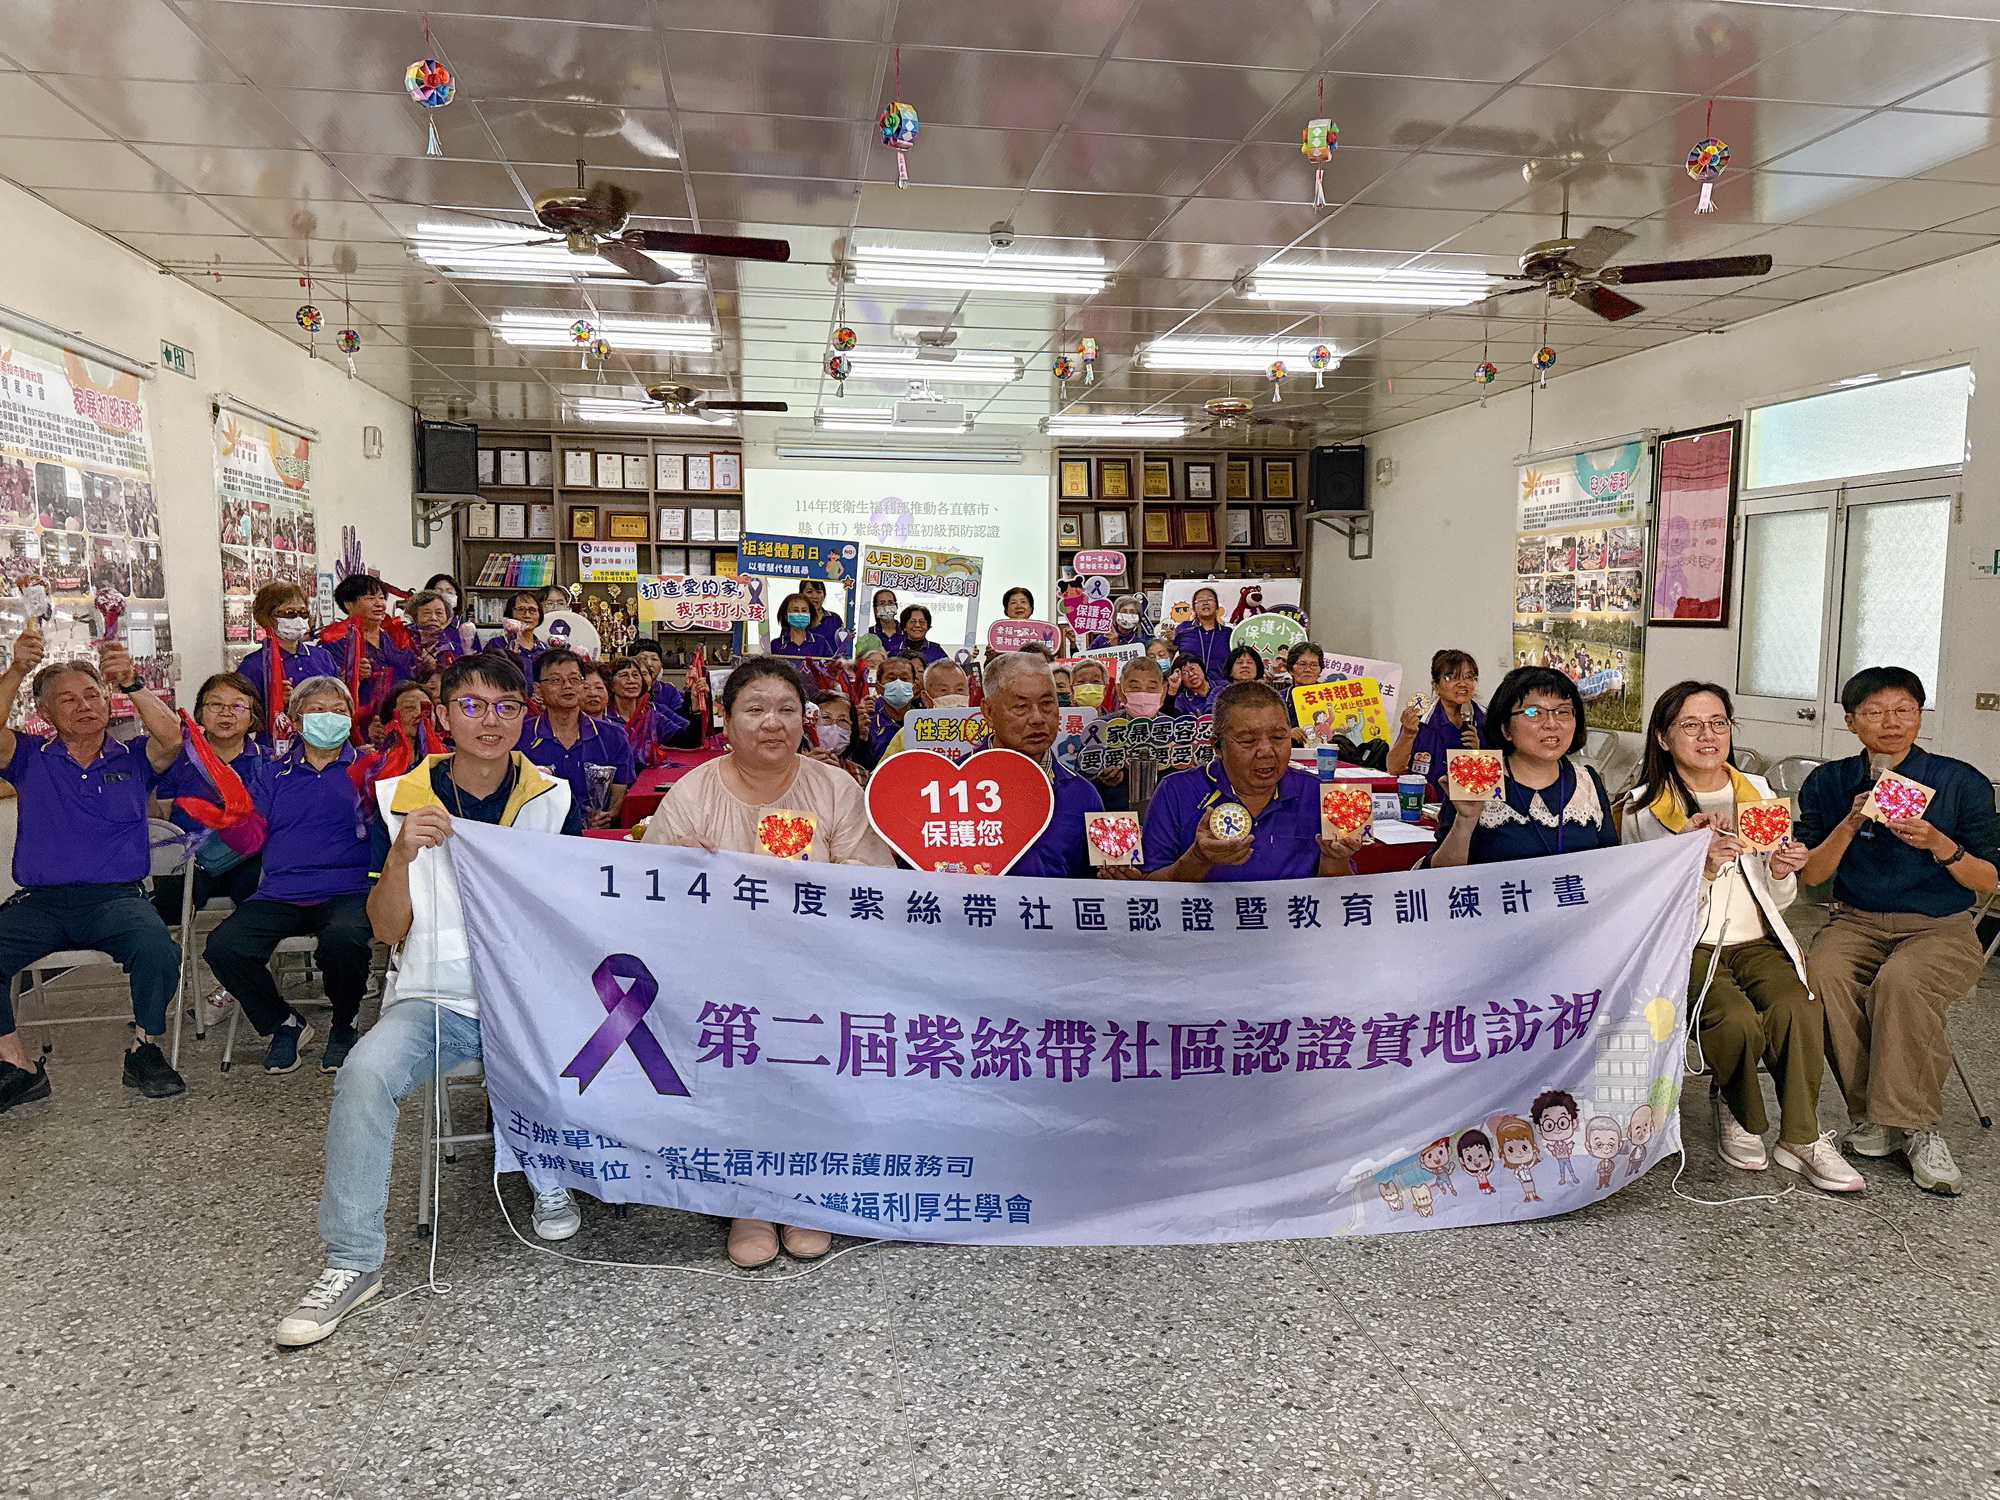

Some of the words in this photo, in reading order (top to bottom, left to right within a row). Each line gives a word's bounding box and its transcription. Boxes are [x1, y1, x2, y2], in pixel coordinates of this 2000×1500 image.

[1590, 471, 1629, 496] 兒少福利
[795, 499, 999, 516] 114年度衛生福利部推動各直轄市、
[798, 521, 1000, 538] 縣（市）紫絲帶社區初級預防認證
[742, 540, 820, 561] 拒絕體罰日
[866, 551, 926, 570] 4月30日
[865, 568, 979, 596] 國際不打小孩日
[676, 602, 765, 621] 我不打小孩
[1076, 605, 1112, 619] 保護令
[1074, 616, 1111, 632] 保護您
[1245, 620, 1304, 645] 保護小孩
[1302, 681, 1364, 706] 支持發聲
[1106, 721, 1213, 744] 家暴零容忍
[919, 780, 1002, 814] 113
[920, 819, 1004, 848] 保護您
[600, 864, 1590, 932] 114年度紫絲帶社區認證暨教育訓練計畫
[695, 988, 1602, 1082] 第二屆紫絲帶社區認證實地訪視
